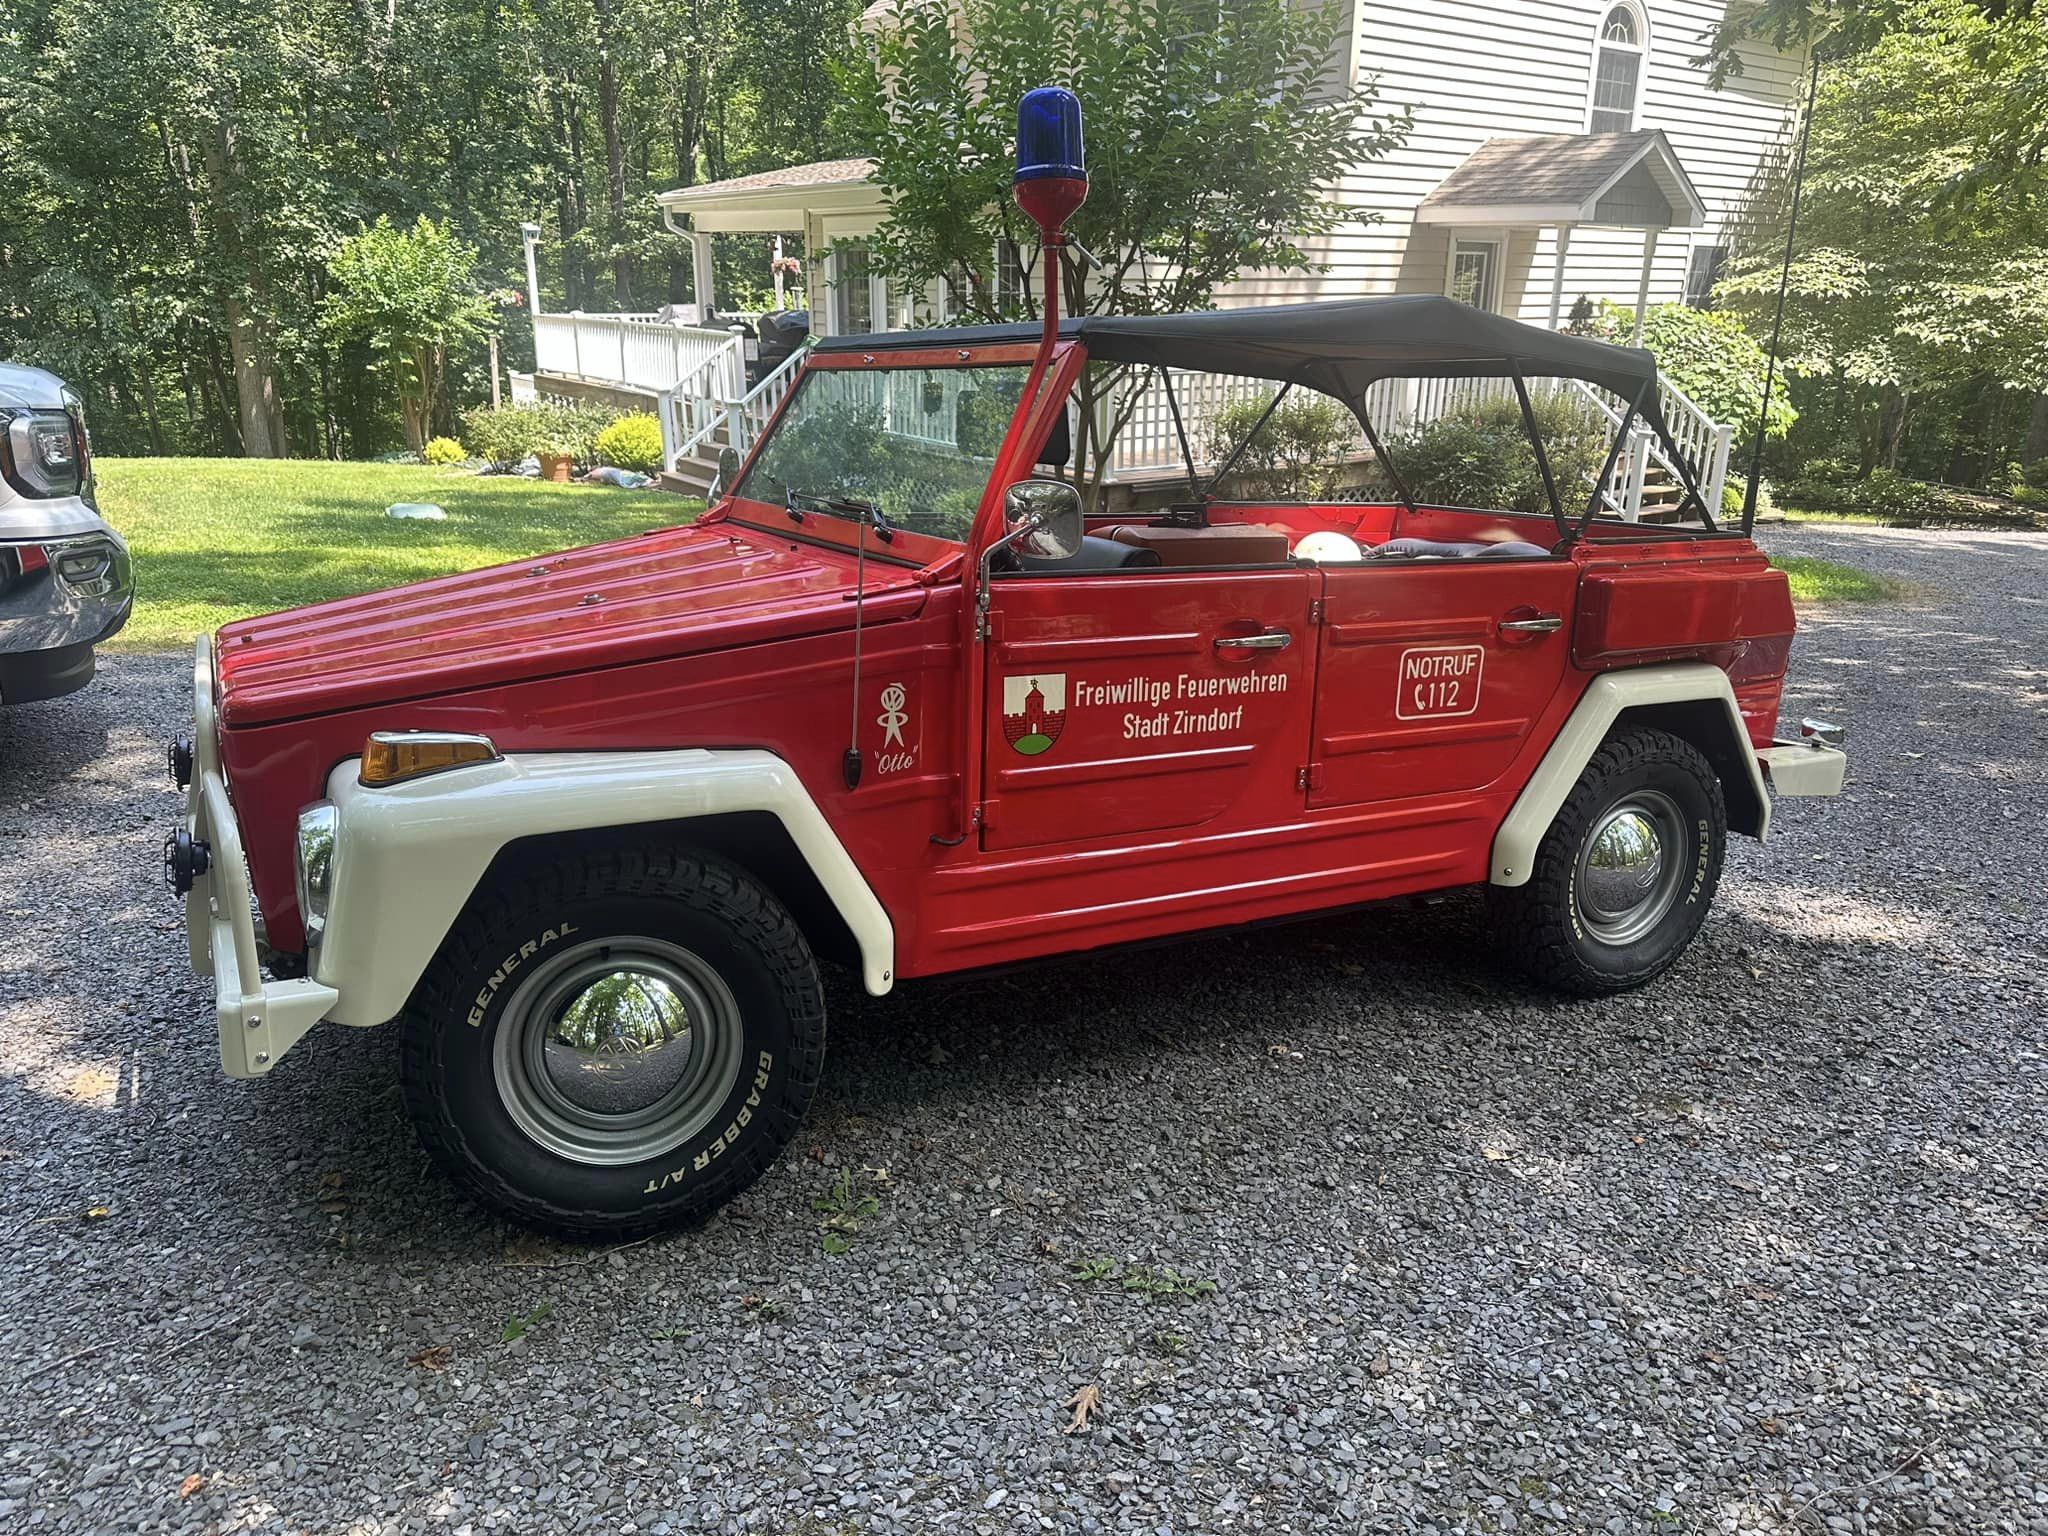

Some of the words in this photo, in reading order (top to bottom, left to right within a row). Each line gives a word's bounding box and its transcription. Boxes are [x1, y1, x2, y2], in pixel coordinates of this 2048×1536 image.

[1406, 654, 1478, 680] NOTRUF
[1074, 676, 1171, 708] Freiwillige
[1177, 669, 1288, 699] Feuerwehren
[1428, 680, 1460, 708] 112
[1123, 711, 1170, 739] Stadt
[1173, 704, 1243, 735] Zirndorf
[1686, 819, 1710, 905] GENERAL
[466, 921, 580, 1028] GENERAL
[693, 1050, 774, 1172] GRABBER
[643, 1166, 687, 1194] A/T
